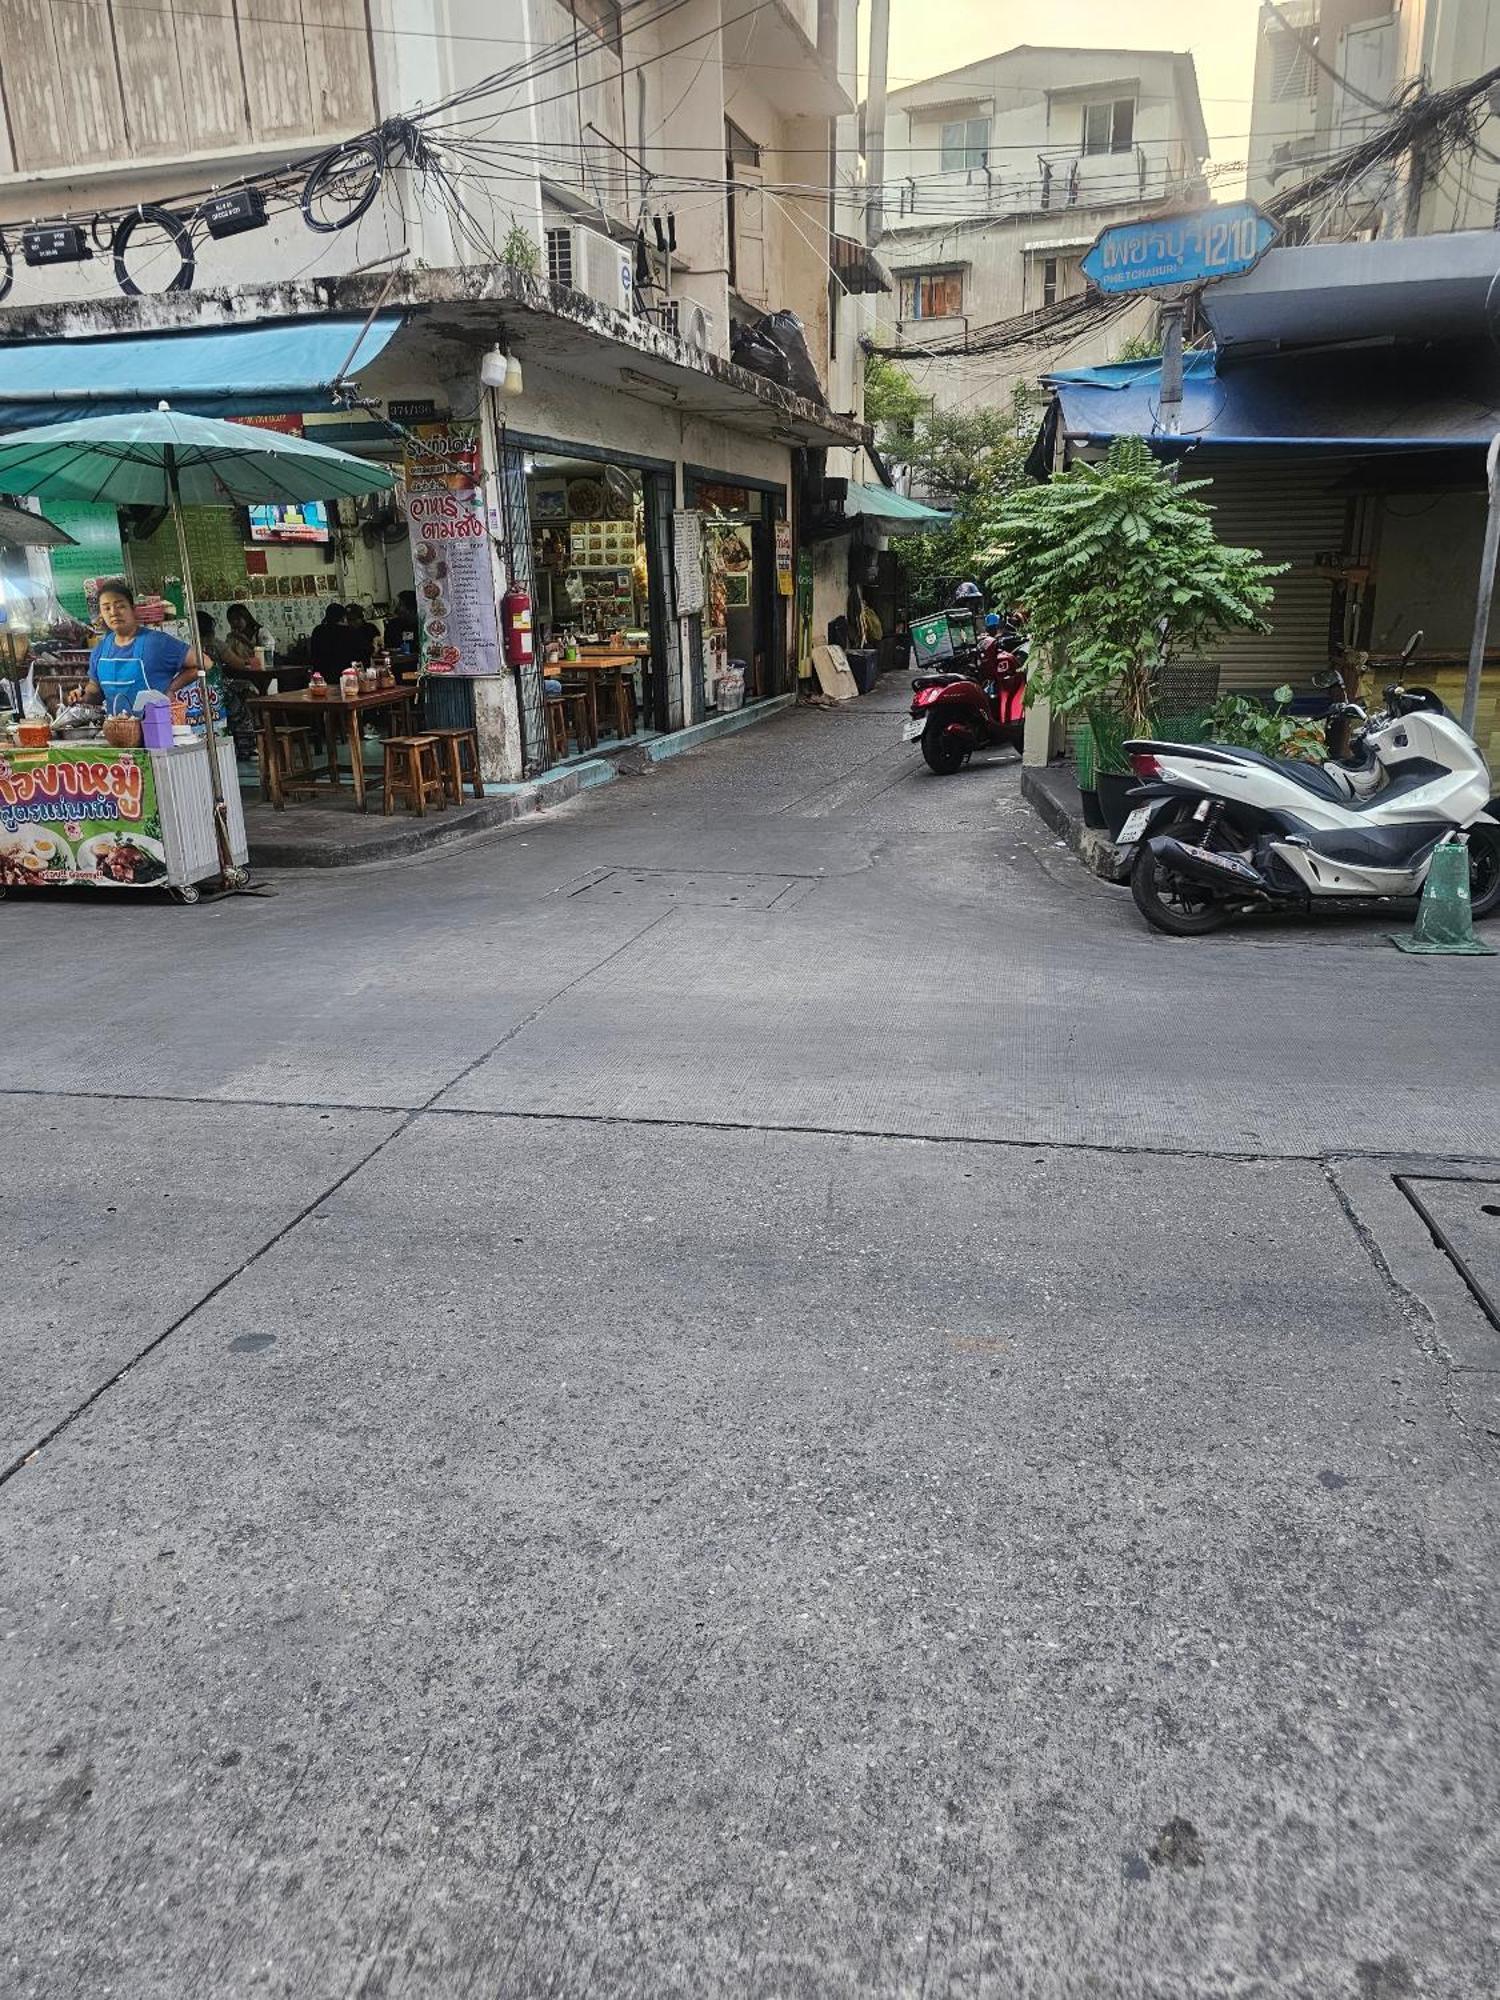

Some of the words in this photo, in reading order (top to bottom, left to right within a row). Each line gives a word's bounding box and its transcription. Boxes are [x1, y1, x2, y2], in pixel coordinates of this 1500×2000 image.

[1103, 264, 1177, 285] PHETCHABURI
[410, 495, 458, 521] อาหาร
[421, 512, 483, 540] ตามสั่ง
